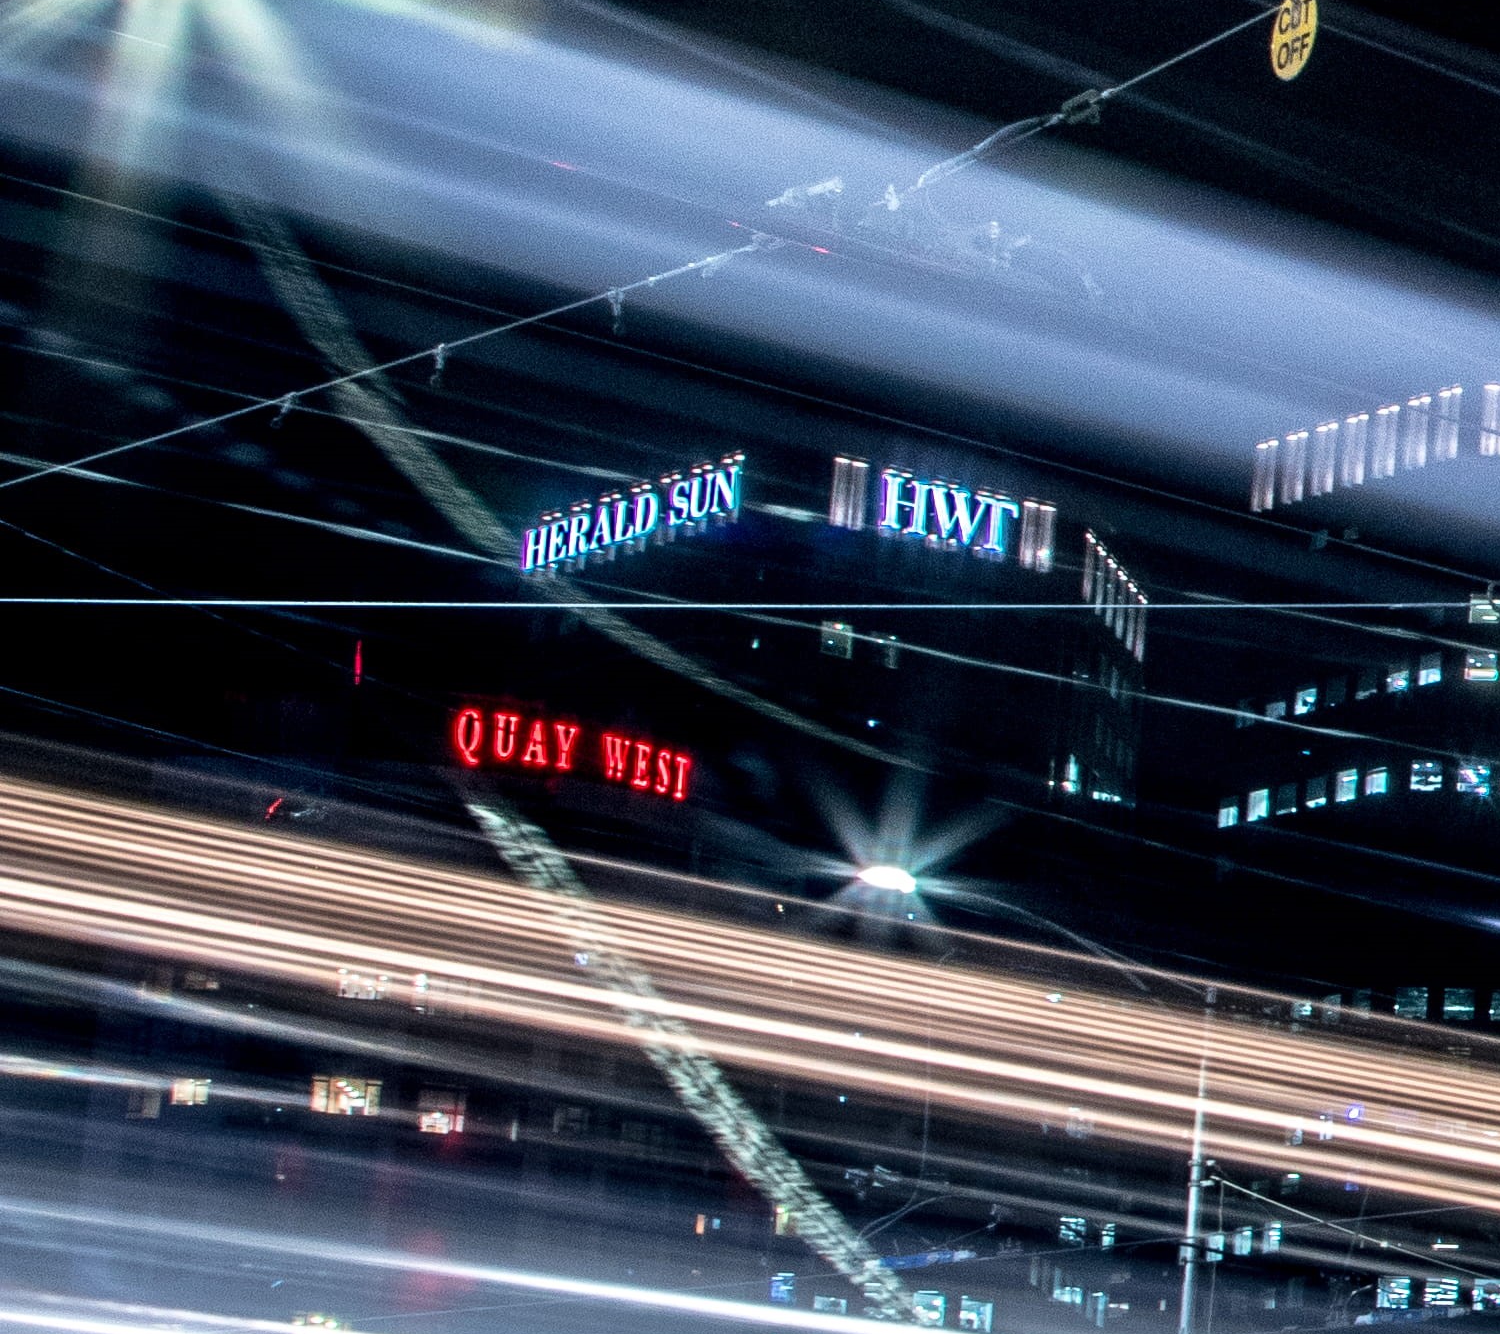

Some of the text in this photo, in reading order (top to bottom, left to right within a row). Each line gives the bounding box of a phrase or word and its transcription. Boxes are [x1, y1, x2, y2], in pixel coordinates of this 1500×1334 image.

[1278, 33, 1310, 70] OFF
[523, 466, 742, 572] HERALD SUN
[878, 471, 1019, 553] HWT
[455, 709, 692, 800] QUAY WEST
